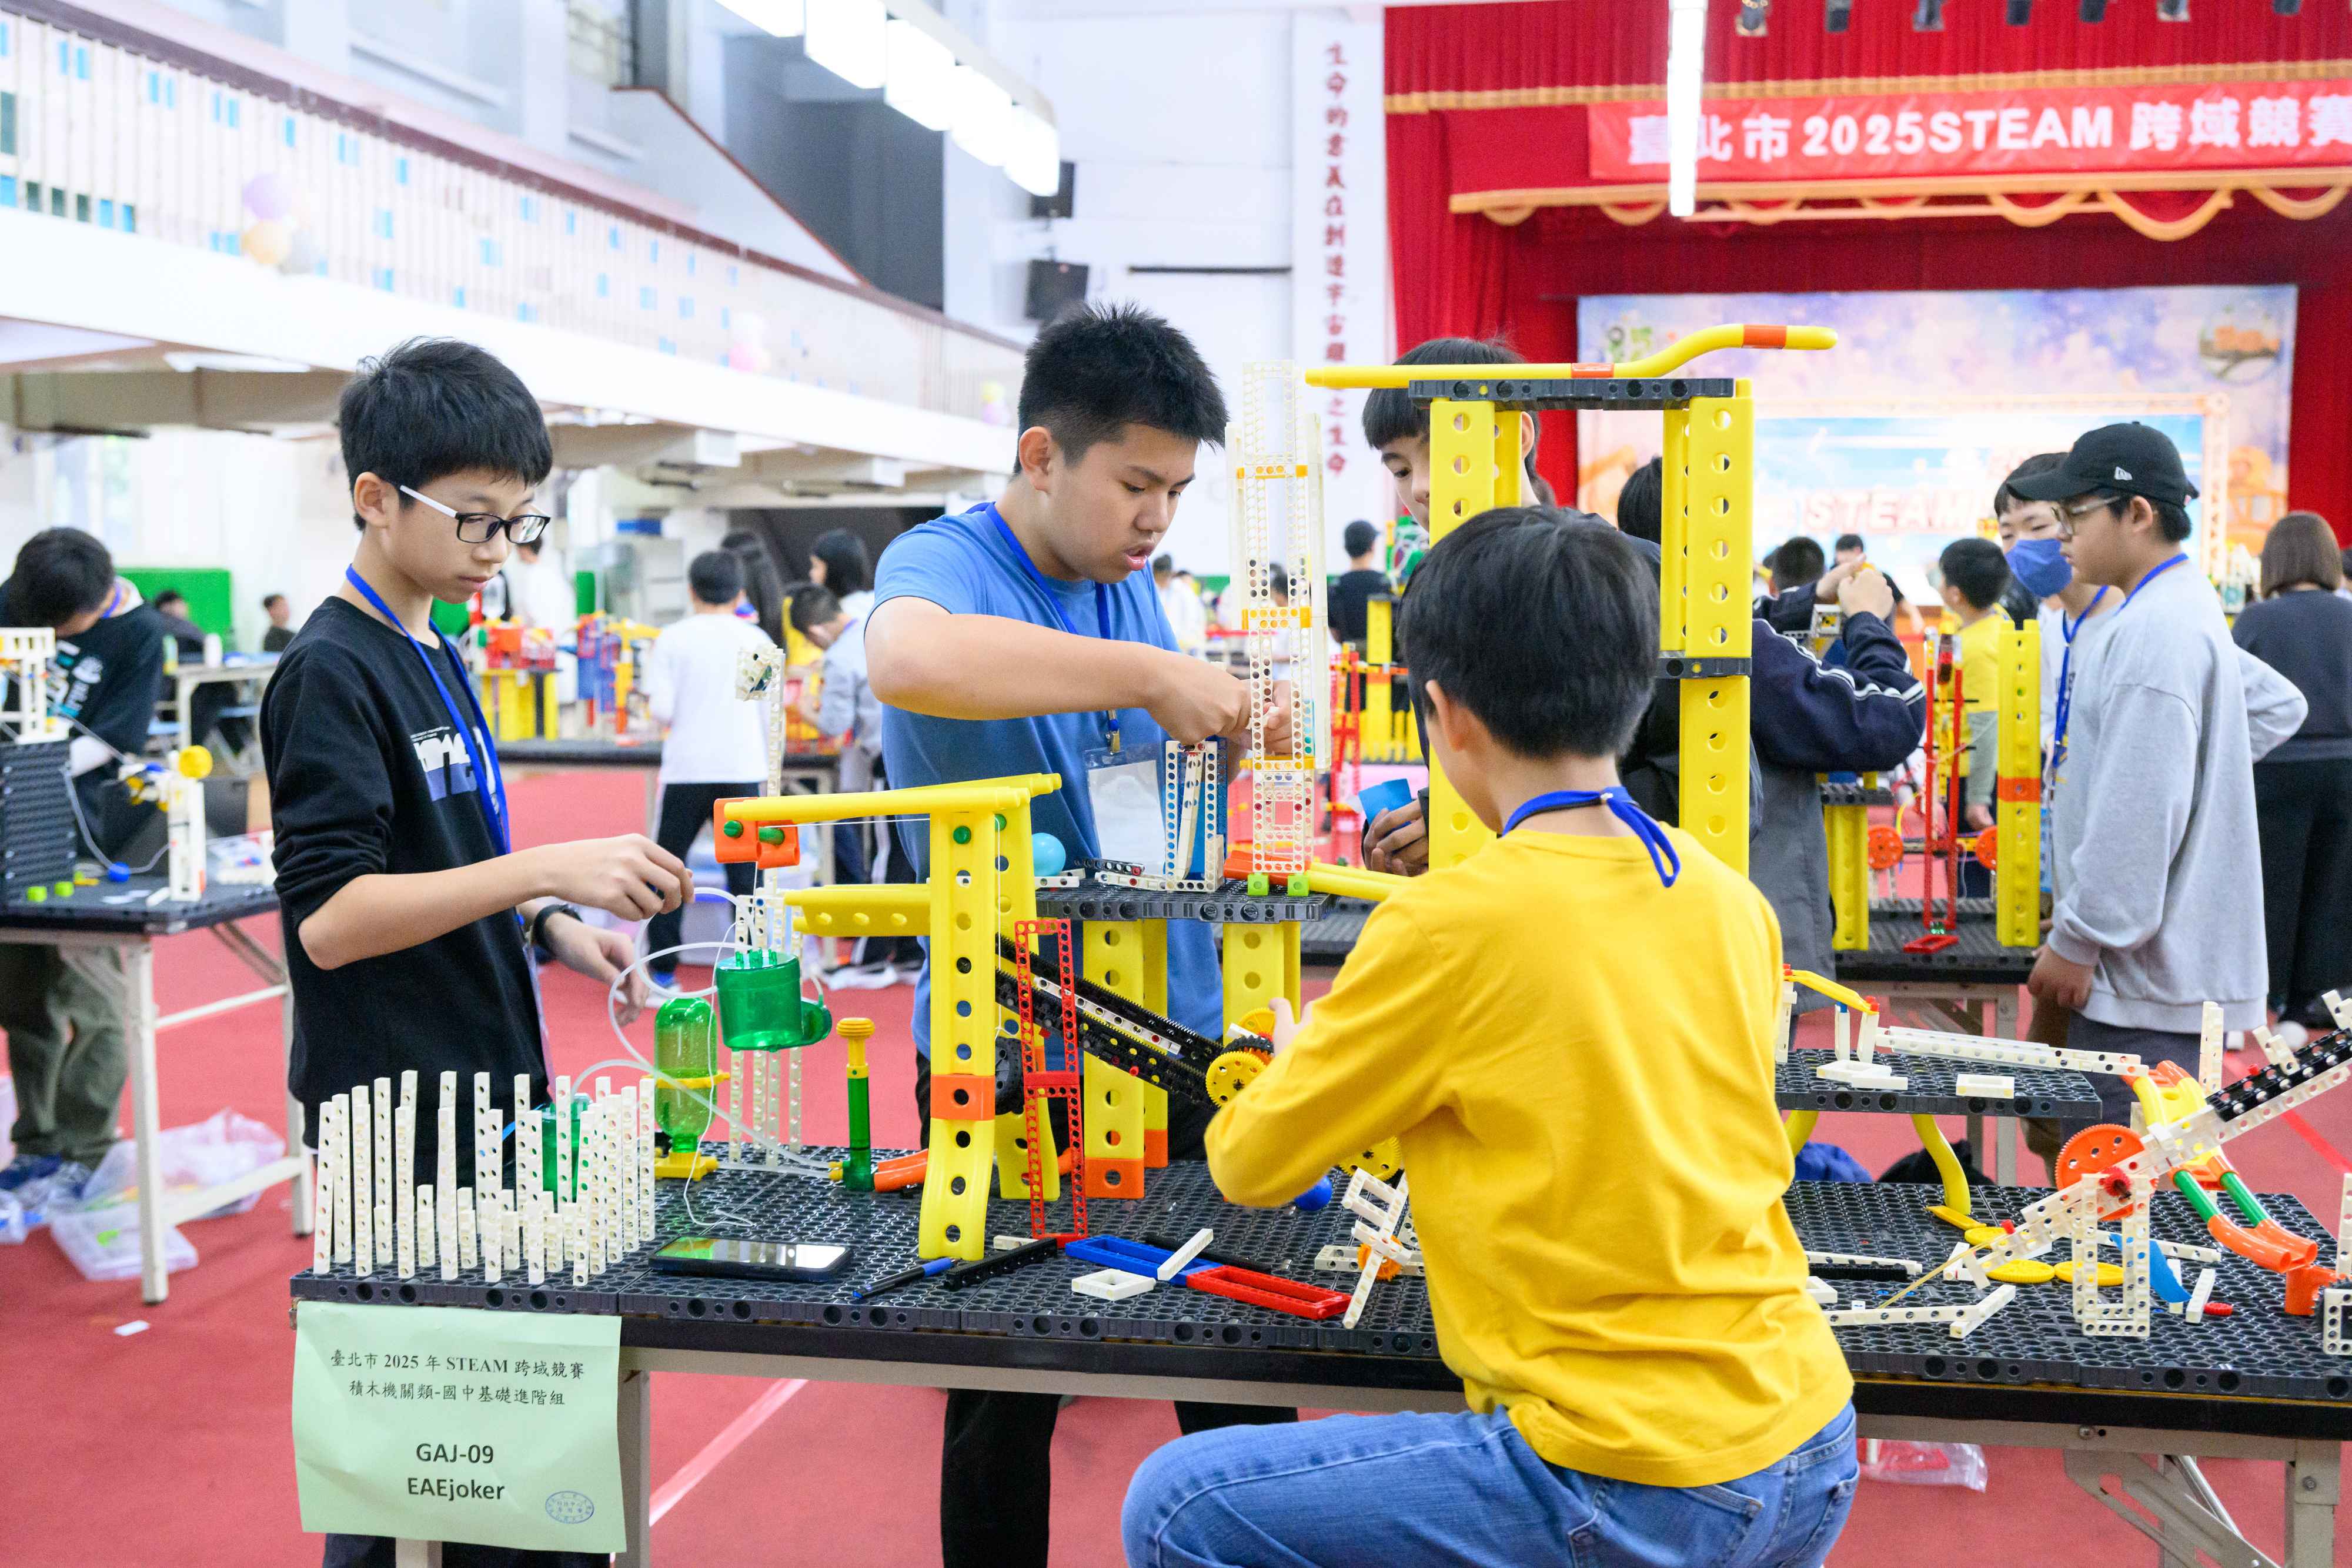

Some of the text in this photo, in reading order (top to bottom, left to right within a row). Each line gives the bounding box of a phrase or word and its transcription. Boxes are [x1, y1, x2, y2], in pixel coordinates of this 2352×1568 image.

[1802, 106, 2113, 156] 2025STEAM
[2130, 94, 2352, 151] 跨域競賽
[330, 1349, 584, 1380] 臺北市 2025 年 STEAM 跨域競賽
[416, 1443, 494, 1464] GAJ-09
[407, 1477, 505, 1502] EAEjoker
